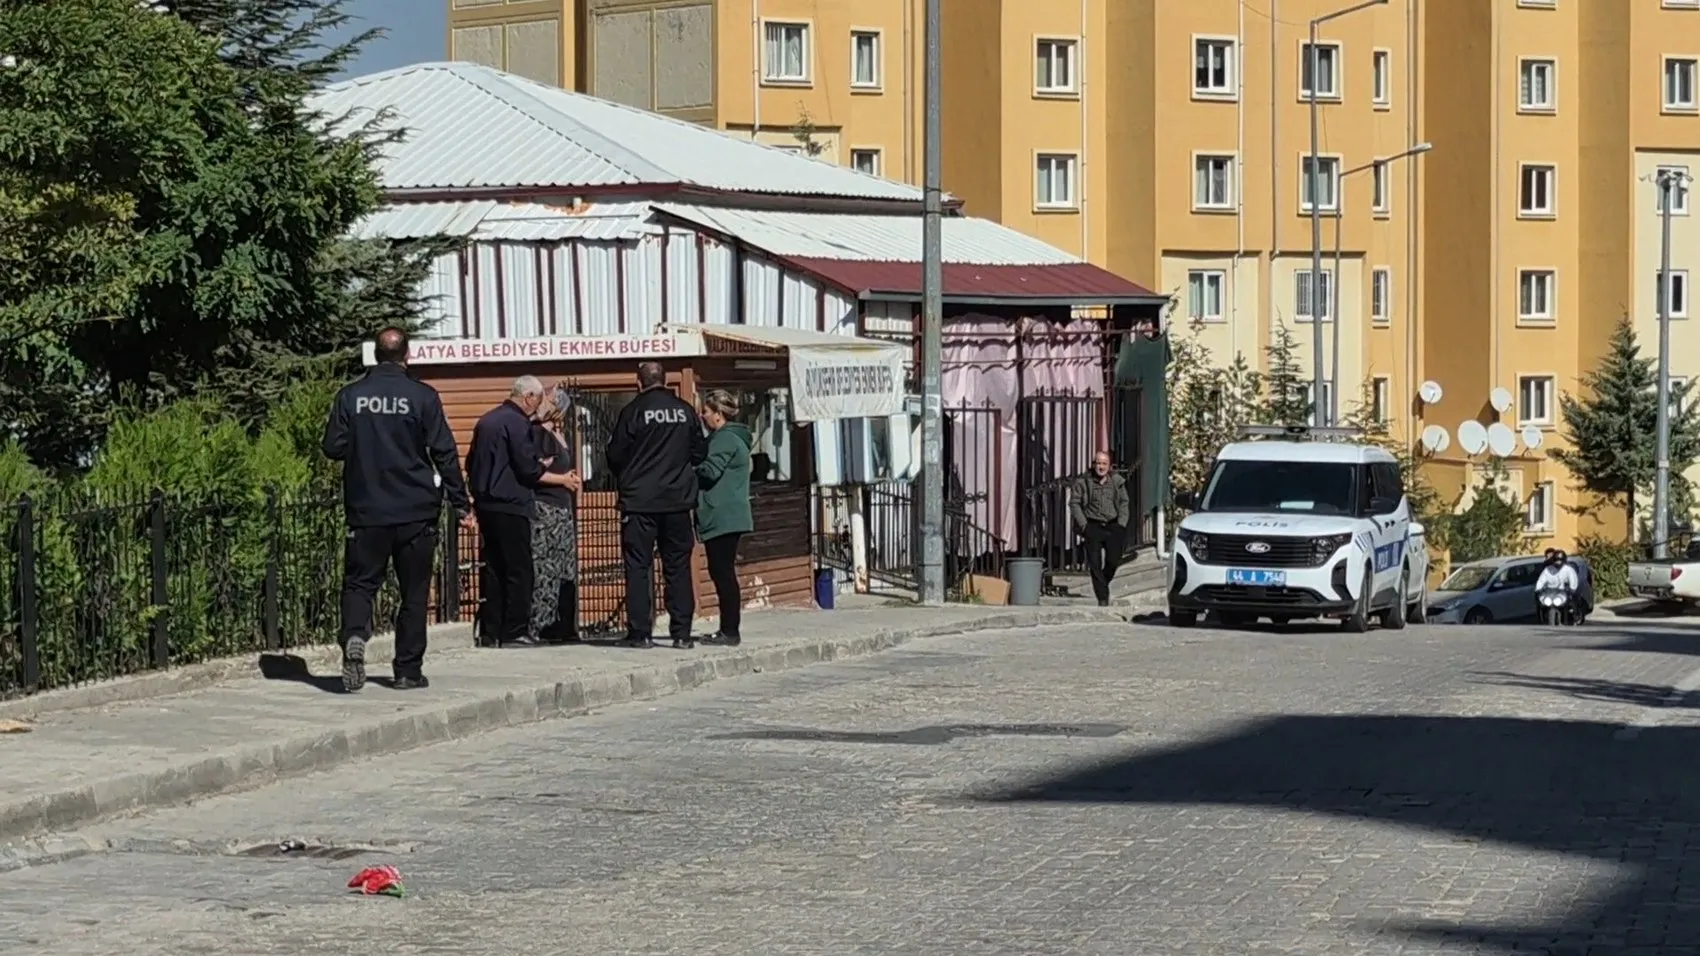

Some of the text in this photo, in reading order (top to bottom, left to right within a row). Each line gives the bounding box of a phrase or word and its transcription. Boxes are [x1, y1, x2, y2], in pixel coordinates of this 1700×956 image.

[407, 335, 676, 359] LATYA BELEDİYESİ EKMEK BÜFESİ
